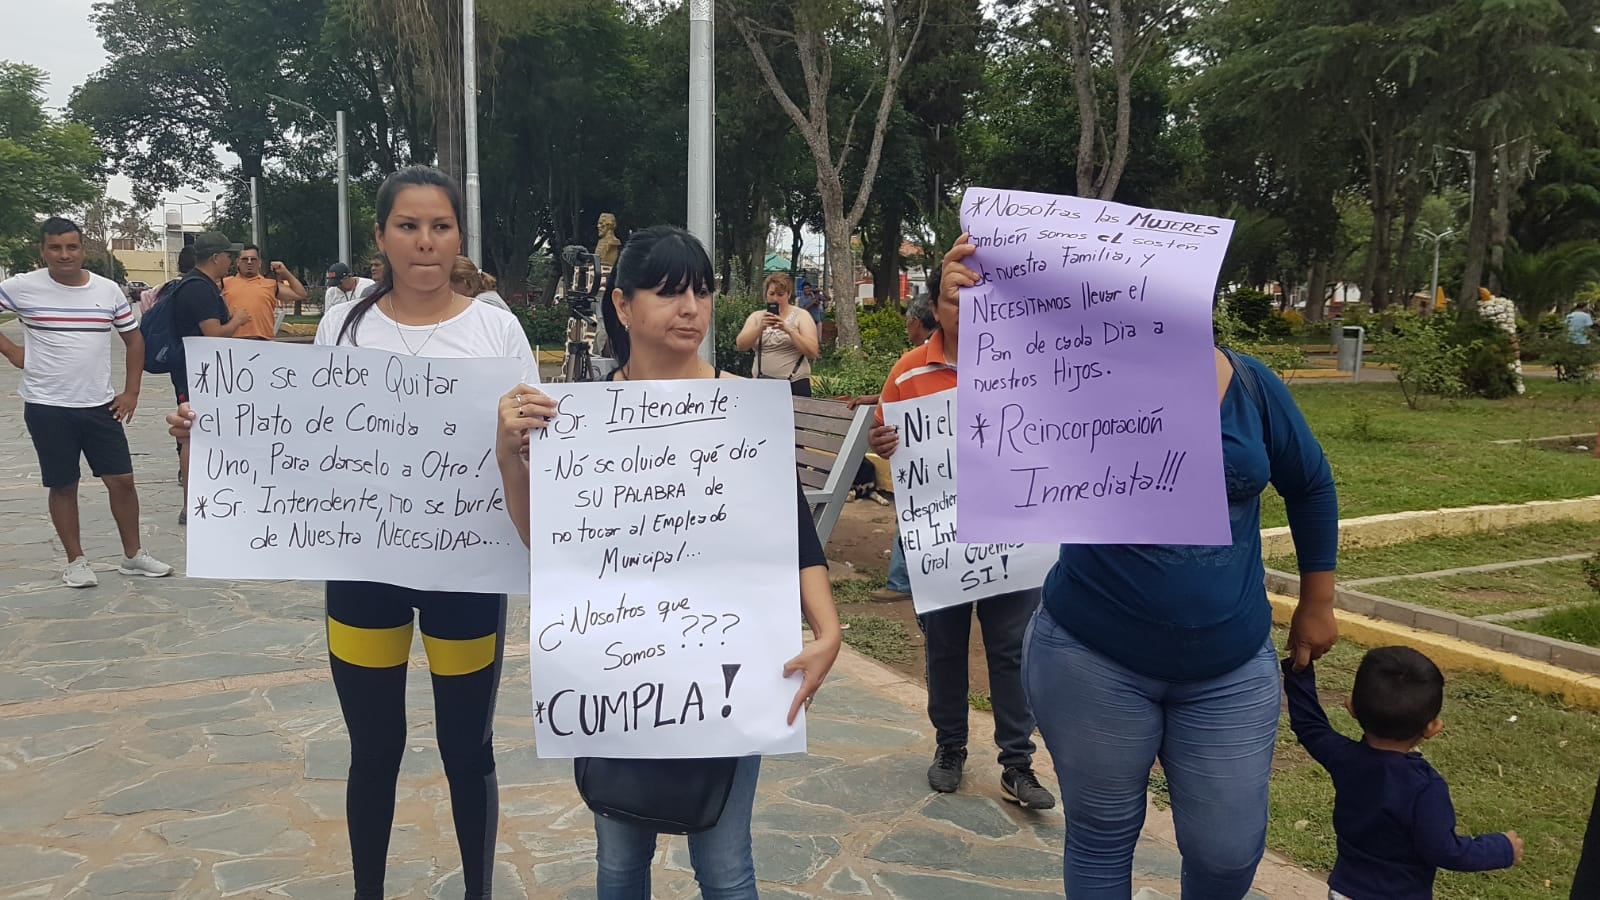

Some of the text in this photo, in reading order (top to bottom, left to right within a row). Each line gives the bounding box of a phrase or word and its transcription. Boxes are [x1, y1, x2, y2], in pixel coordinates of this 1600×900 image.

[985, 194, 1081, 219] Nosotras
[1094, 206, 1120, 224] las
[1036, 228, 1088, 241] somos
[996, 251, 1047, 281] nuestra
[1081, 281, 1122, 311] llevar
[1129, 276, 1147, 302] el
[976, 332, 1011, 366] Pan
[1026, 331, 1046, 355] de
[1153, 321, 1164, 335] a
[216, 348, 459, 402] Nó se debe Quitar
[974, 368, 1038, 393] nuestros
[199, 403, 457, 437] el Plato de Comida a
[554, 393, 588, 434] Sr.
[997, 403, 1164, 457] Reincorporación
[207, 449, 258, 484] Uno,
[271, 442, 310, 476] Para
[402, 464, 412, 477] a
[594, 461, 615, 473] se
[621, 445, 676, 474] olvide
[389, 493, 413, 513] no
[424, 499, 445, 514] se
[454, 488, 504, 516] burle
[574, 476, 724, 508] SU PALABRA de
[250, 525, 278, 549] de
[289, 521, 362, 549] Nuestra
[552, 532, 572, 545] no
[580, 517, 621, 543] tocar
[629, 514, 646, 537] al
[657, 597, 691, 623] que
[603, 641, 666, 671] Somos
